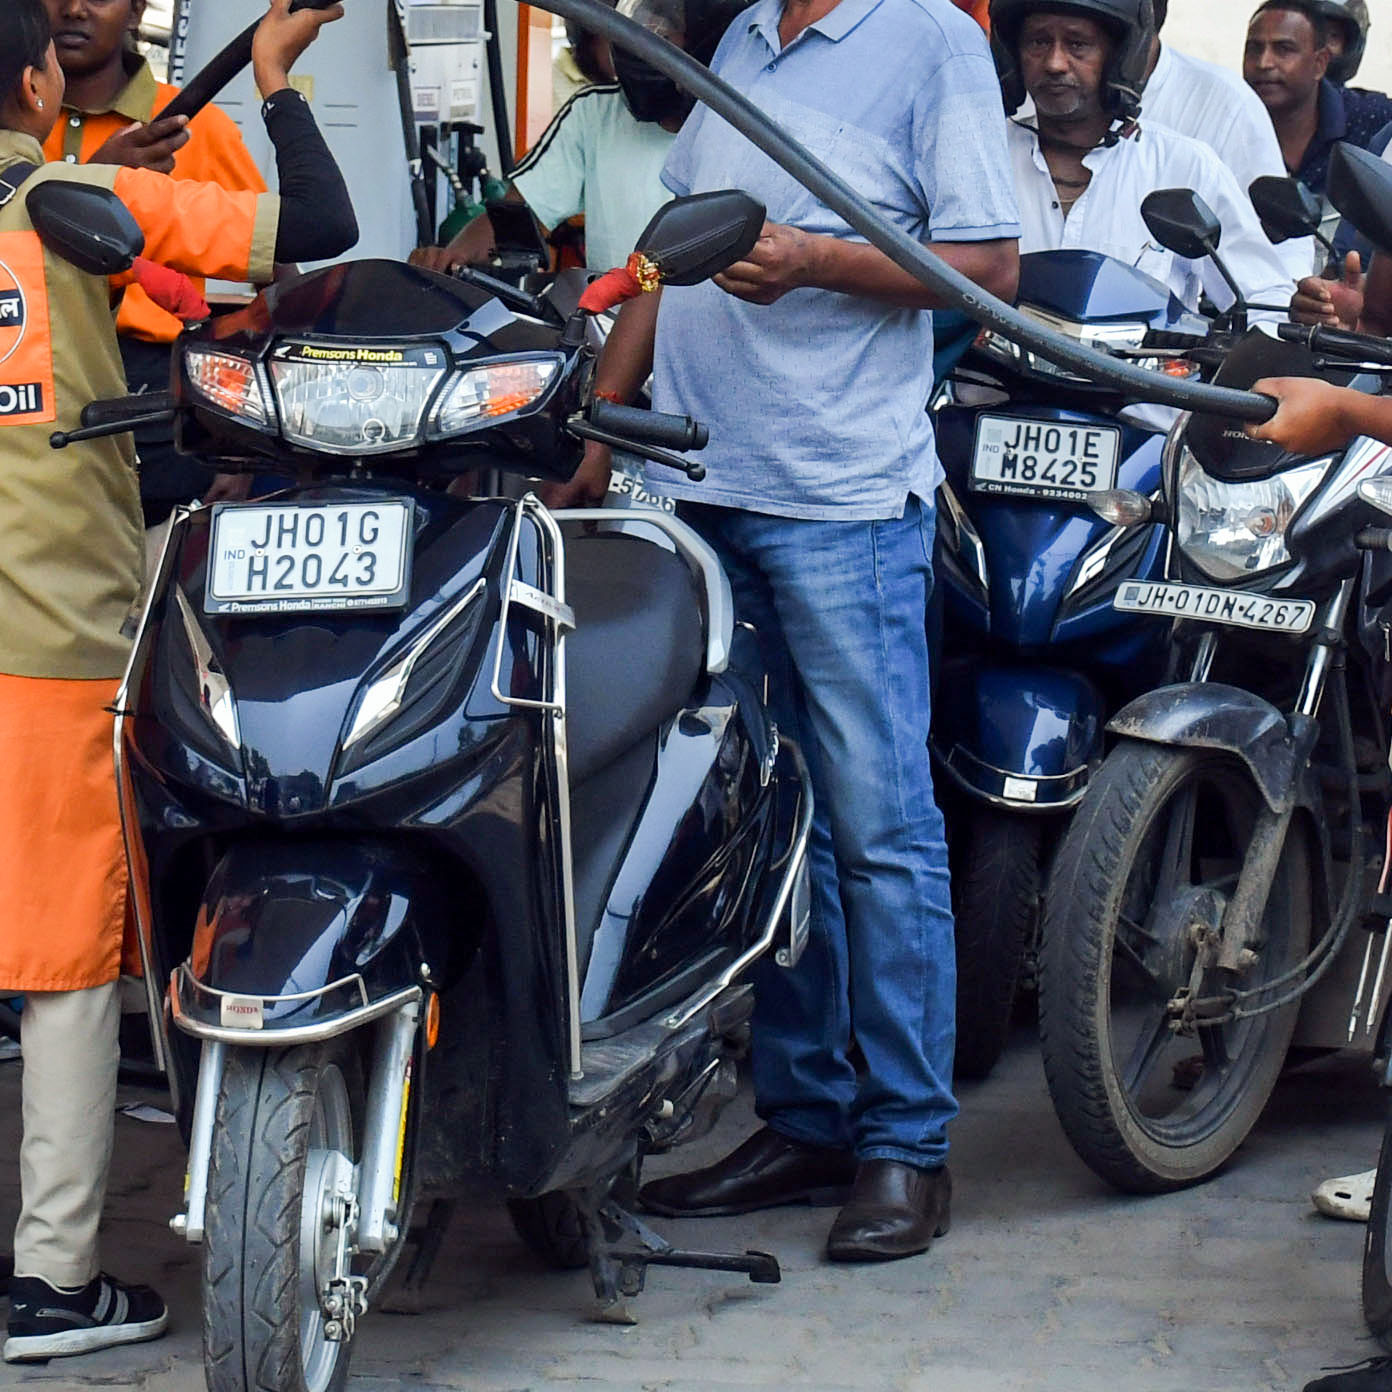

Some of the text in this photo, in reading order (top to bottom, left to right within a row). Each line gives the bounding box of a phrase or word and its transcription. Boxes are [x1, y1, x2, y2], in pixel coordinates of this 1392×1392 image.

[301, 345, 356, 360] Premsons
[357, 348, 403, 362] Honda
[982, 443, 1000, 454] IND
[1004, 424, 1102, 459] JH01E
[987, 483, 1002, 493] CN
[1004, 485, 1036, 496] Honda
[250, 510, 380, 549] JH01G
[223, 549, 246, 561] IND
[246, 551, 377, 592] H2043
[231, 602, 278, 613] Premsons
[279, 599, 312, 611] Honda
